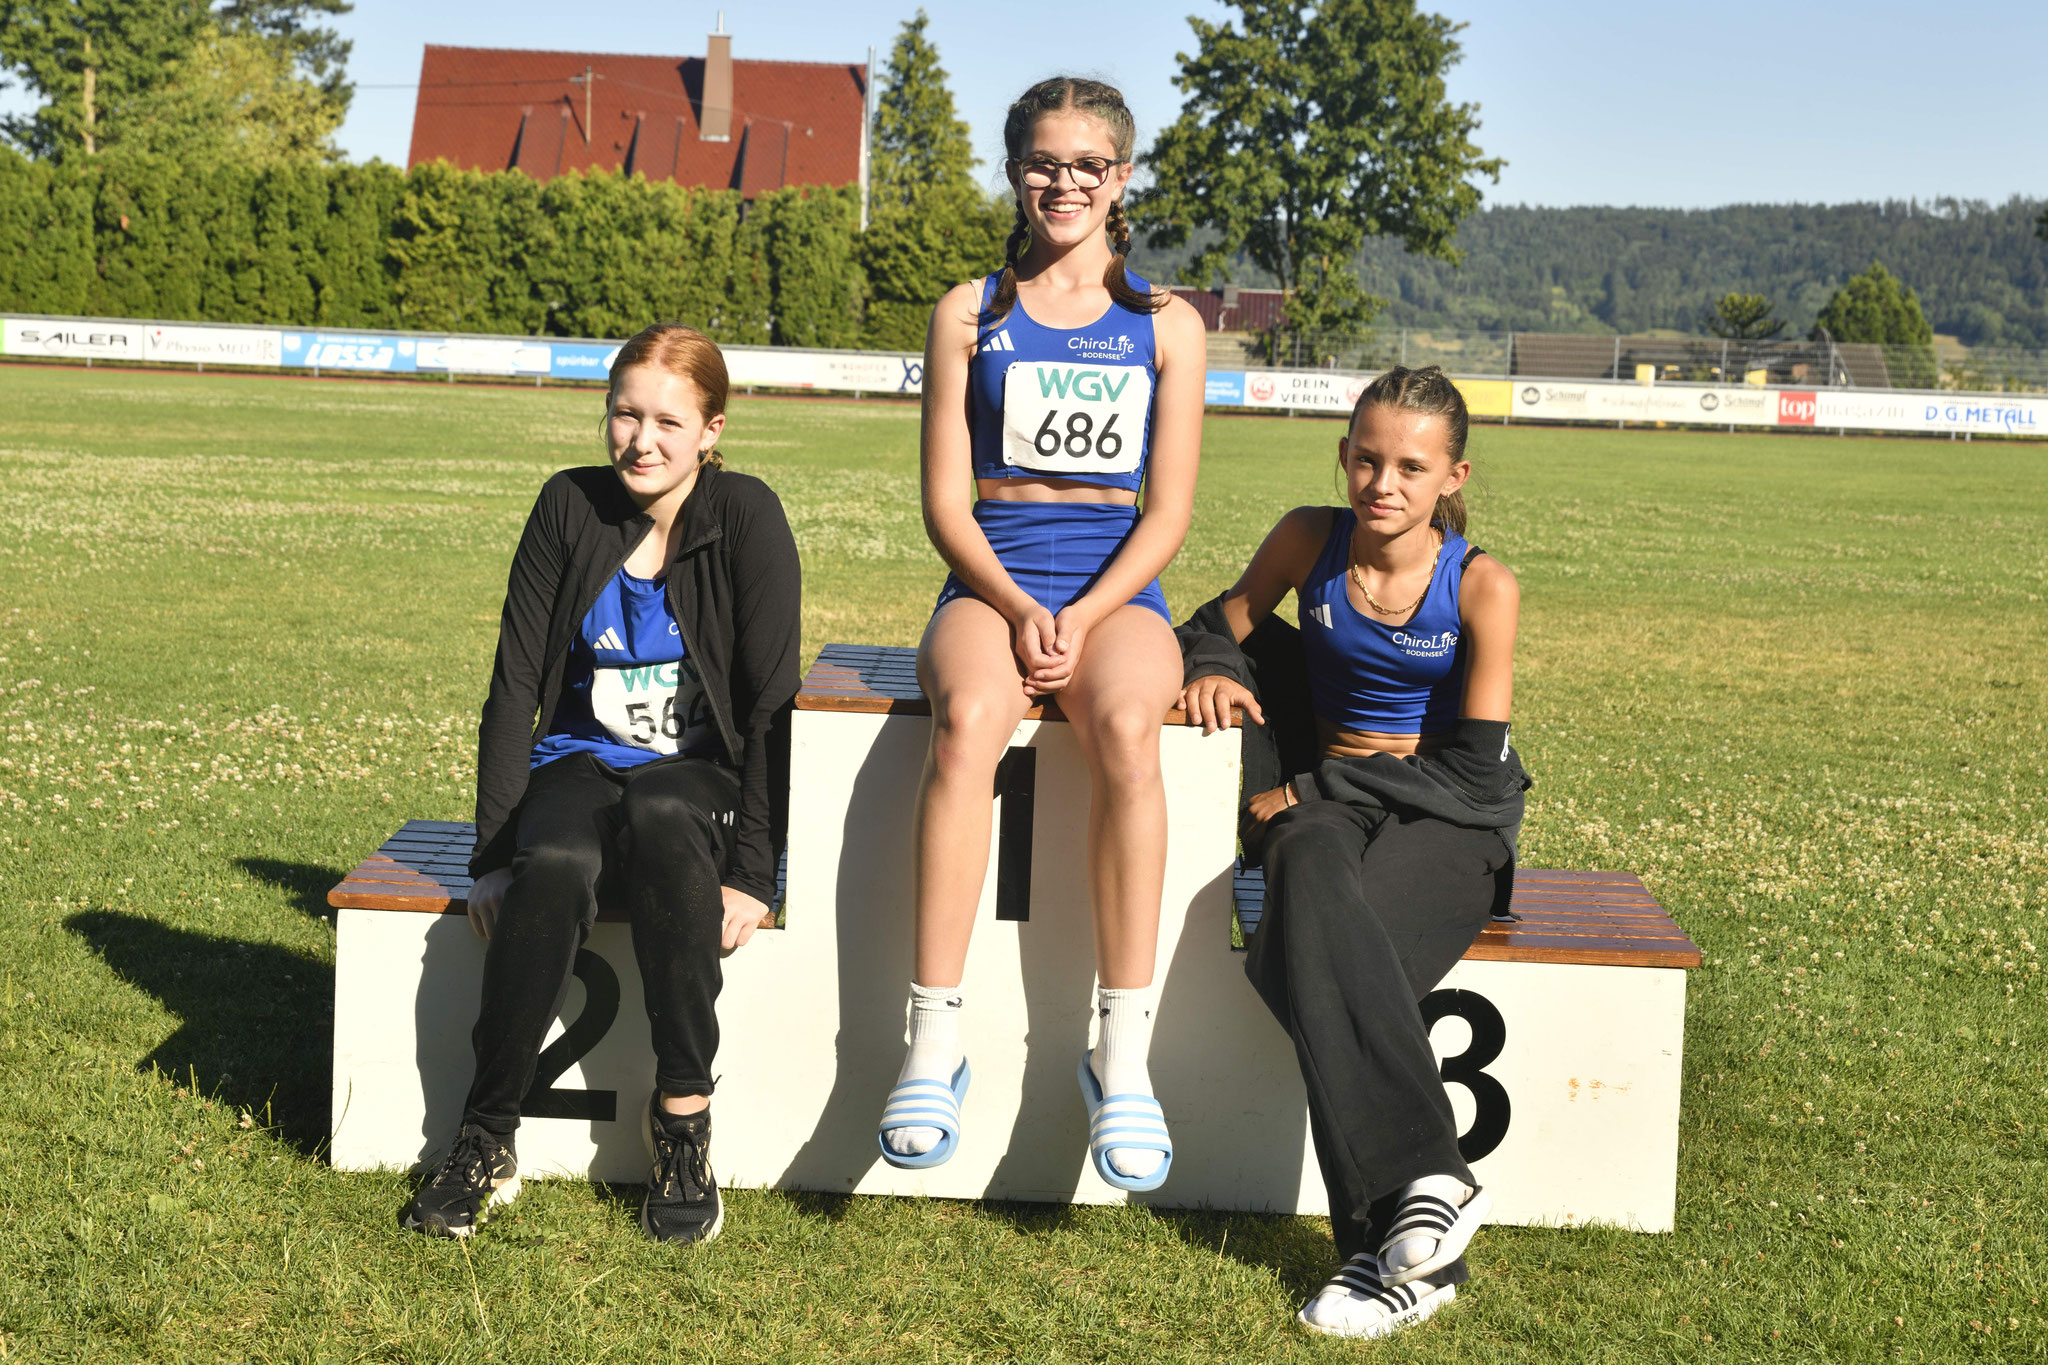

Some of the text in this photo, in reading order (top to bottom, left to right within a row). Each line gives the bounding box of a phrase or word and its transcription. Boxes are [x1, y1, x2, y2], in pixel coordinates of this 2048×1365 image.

[20, 330, 128, 347] SAILER
[1067, 335, 1135, 355] ChiroLife
[1036, 367, 1130, 402] WGV
[1292, 378, 1329, 389] DEIN
[1280, 392, 1339, 405] VEREIN
[1781, 398, 1816, 419] top
[1033, 409, 1123, 460] 686
[1392, 631, 1458, 652] ChiroLife
[1405, 649, 1444, 658] BODENSEE
[625, 687, 715, 745] 564
[992, 746, 1037, 922] 1
[520, 947, 621, 1122] 2
[1417, 988, 1511, 1165] 3
